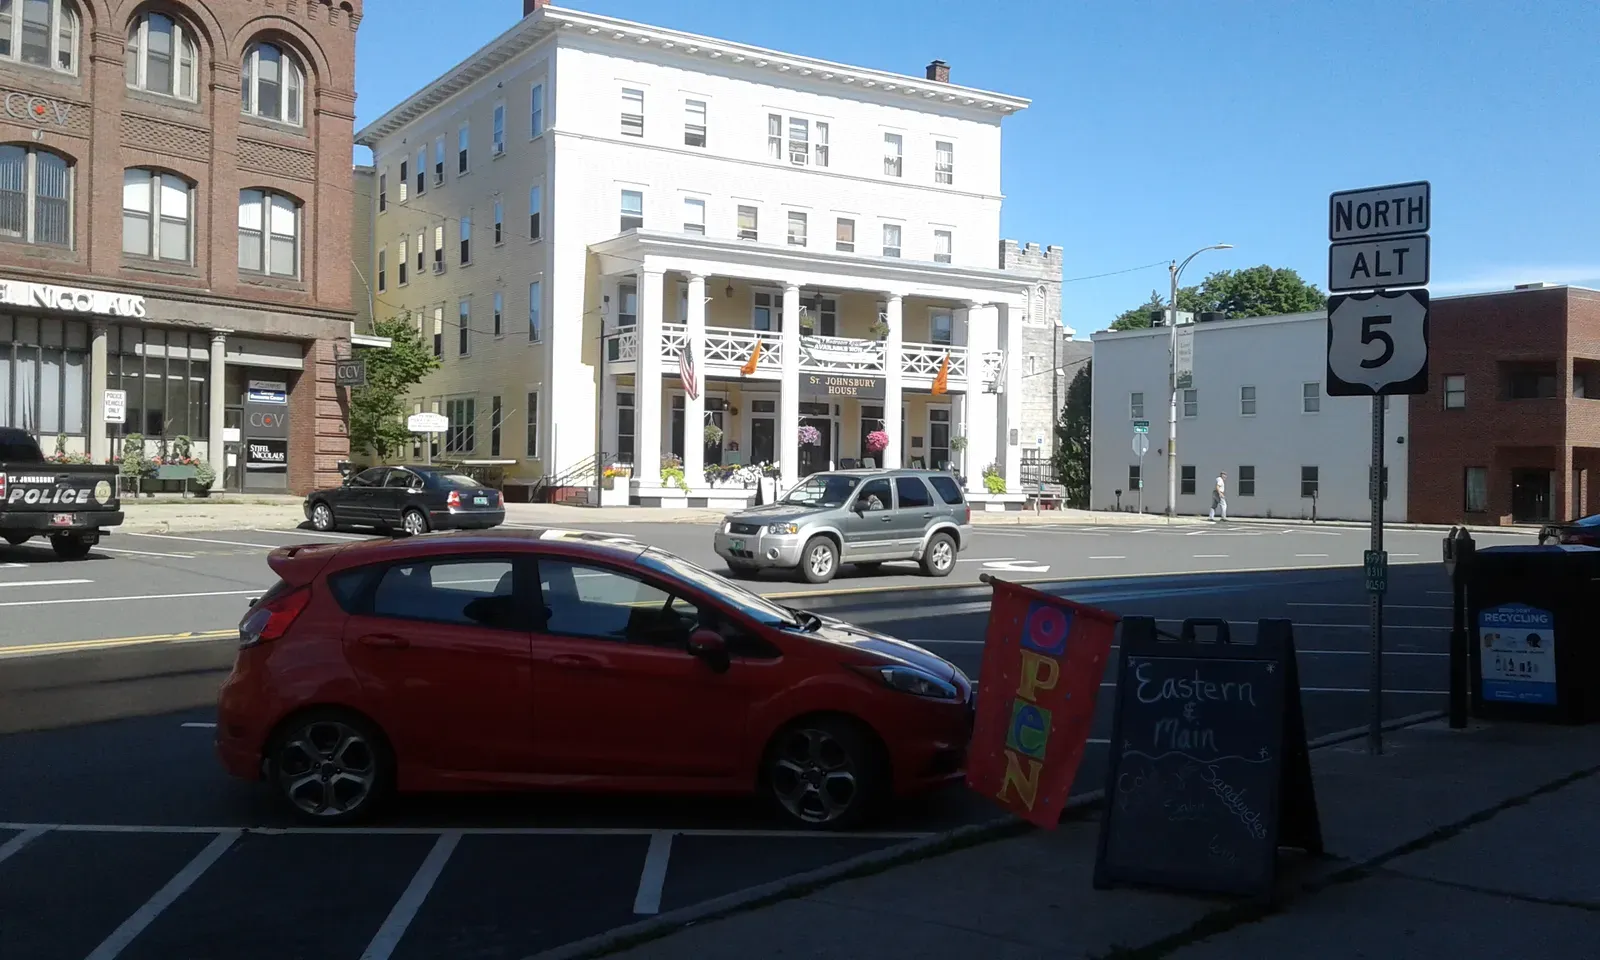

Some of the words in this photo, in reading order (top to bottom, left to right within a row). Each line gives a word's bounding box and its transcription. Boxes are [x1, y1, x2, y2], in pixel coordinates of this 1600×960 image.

[5, 92, 72, 125] CCV
[1335, 195, 1424, 232] NORTH
[1350, 247, 1410, 279] ALT
[1359, 315, 1394, 369] 5
[337, 365, 360, 378] CCV
[825, 377, 876, 388] JOHNSBURY
[828, 386, 857, 395] HOUSE
[250, 412, 285, 428] CCV
[249, 444, 270, 452] STIFEL
[252, 451, 285, 460] NICOLAUS
[8, 488, 92, 504] POLICE
[1484, 613, 1548, 623] RECYCLING
[1135, 662, 1256, 706] Eastern
[1153, 718, 1219, 752] Main
